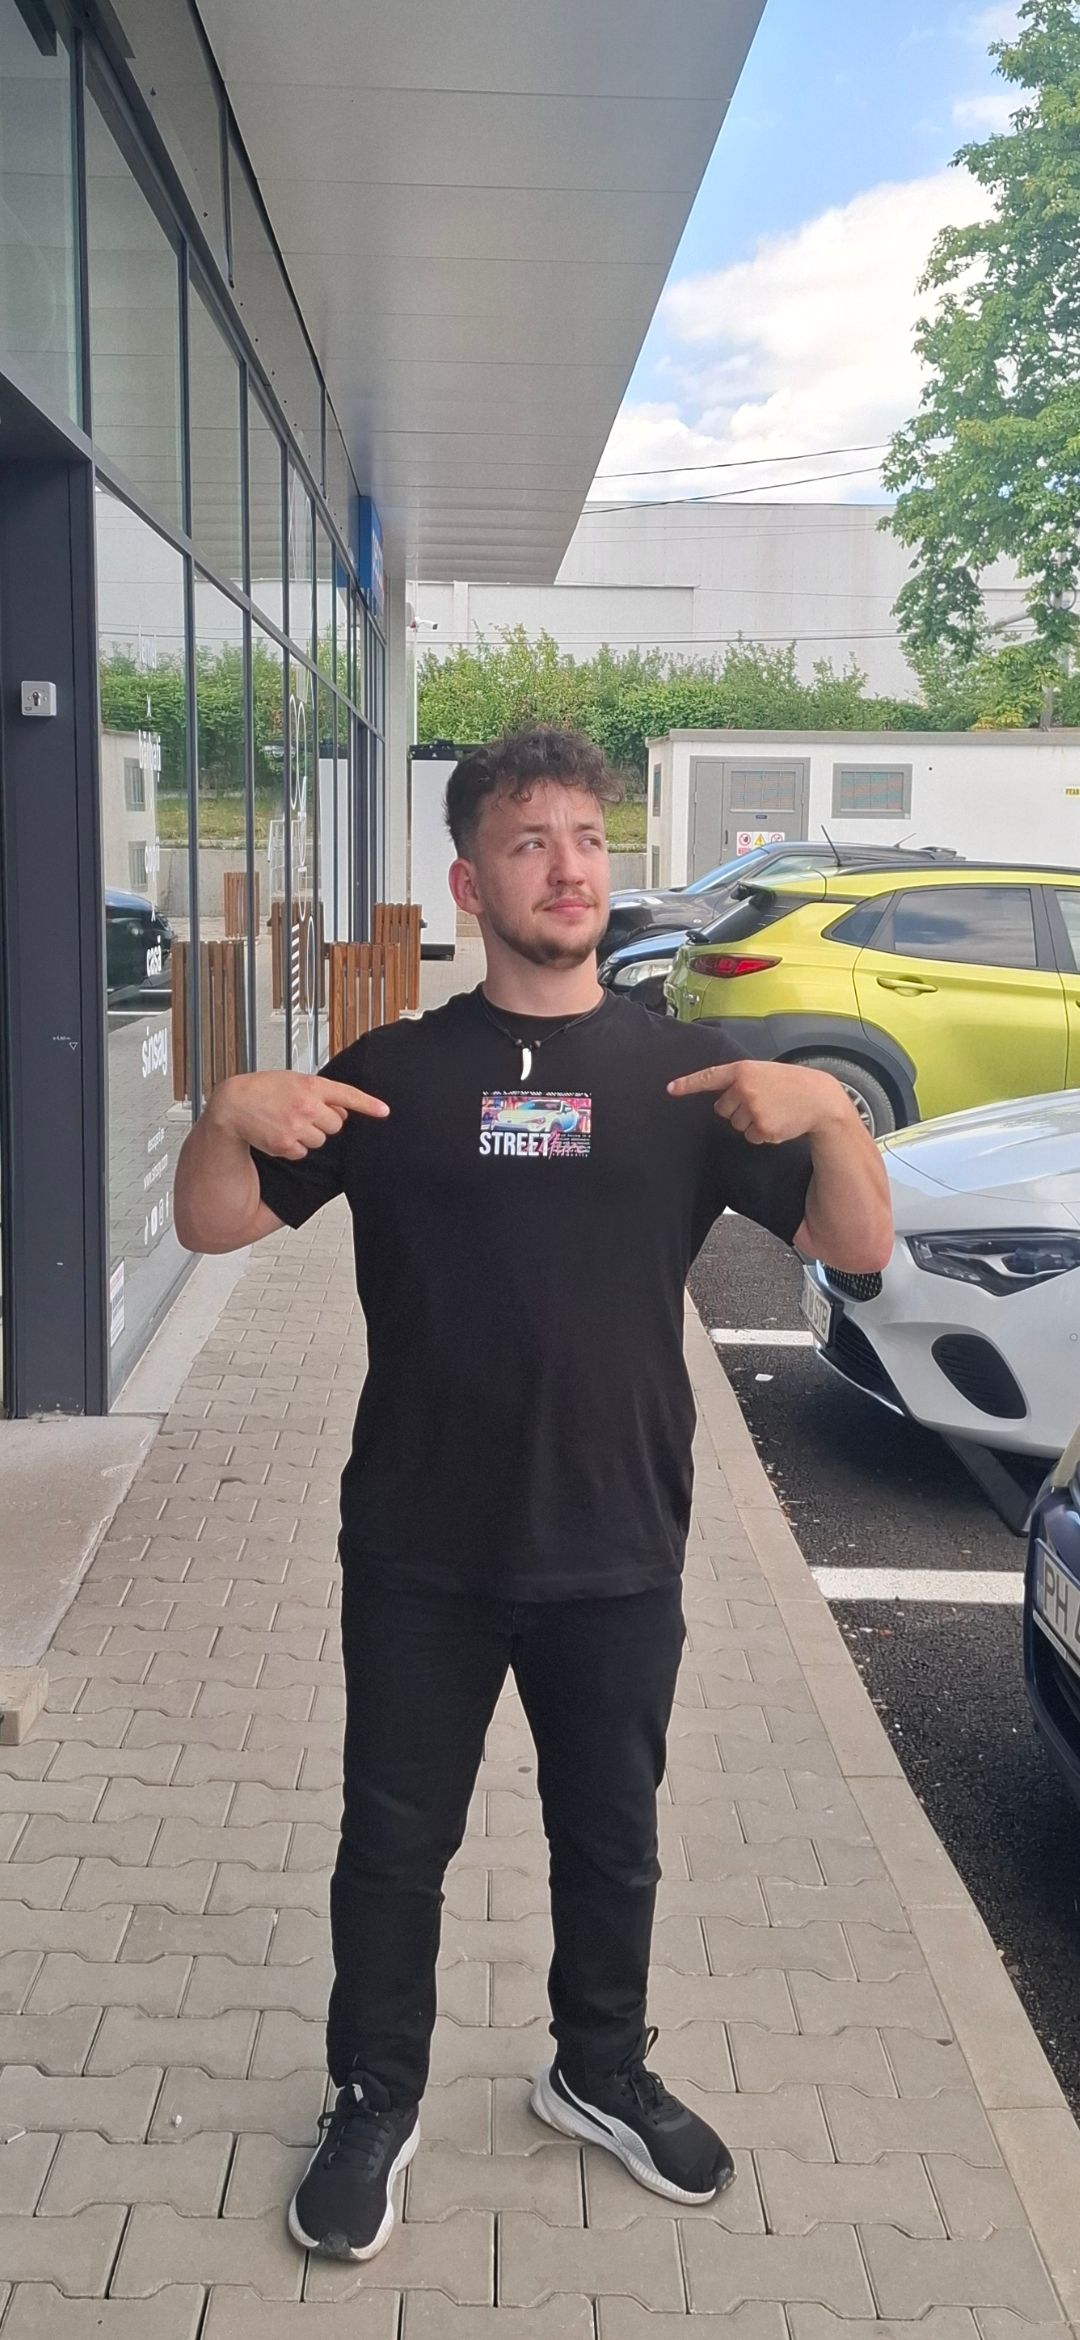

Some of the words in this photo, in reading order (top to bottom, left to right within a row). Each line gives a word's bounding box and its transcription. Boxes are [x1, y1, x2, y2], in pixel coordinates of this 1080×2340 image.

[142, 1026, 167, 1078] sinsay
[479, 1131, 552, 1157] STREET
[1044, 1562, 1068, 1635] PH
